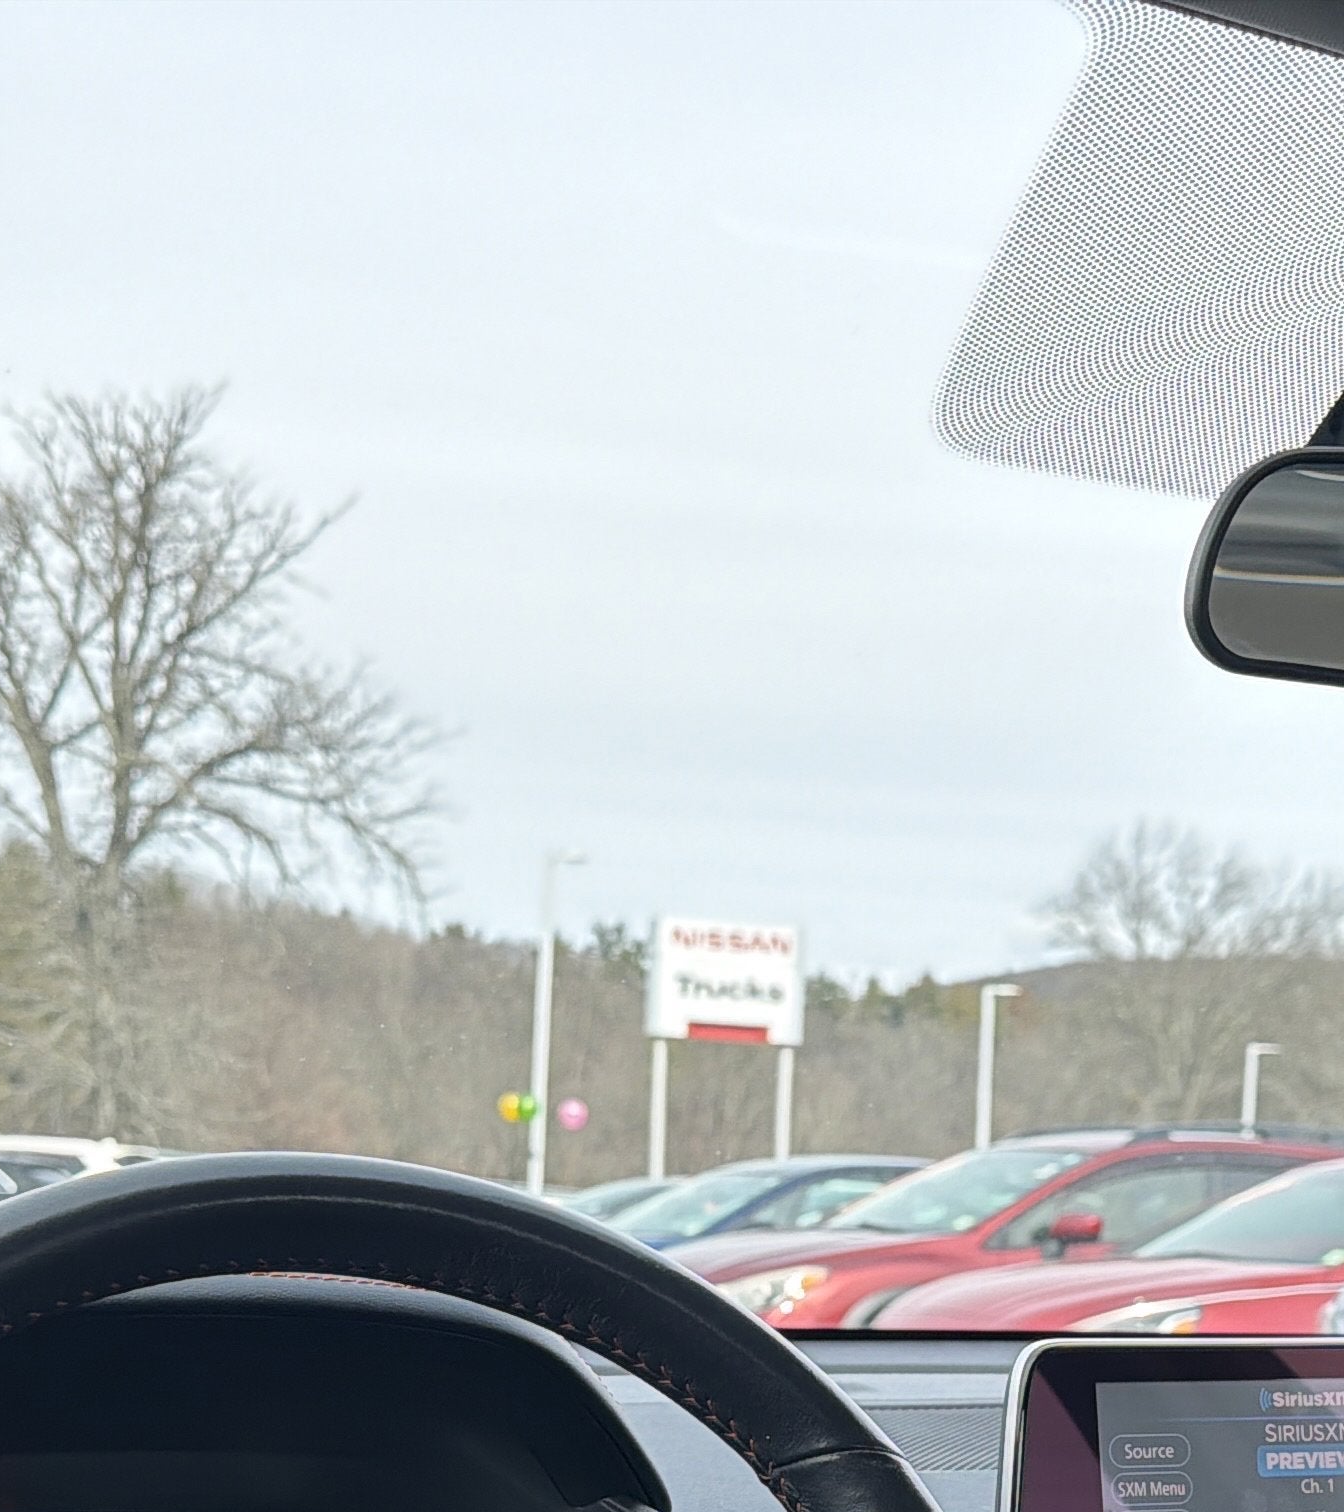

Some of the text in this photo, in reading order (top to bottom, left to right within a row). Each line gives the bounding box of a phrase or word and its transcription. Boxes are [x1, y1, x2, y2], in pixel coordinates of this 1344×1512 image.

[671, 926, 791, 955] NISSAN
[1124, 1443, 1175, 1460] Source
[1118, 1479, 1186, 1498] SXM Menu
[1301, 1478, 1335, 1494] Ch. 1
